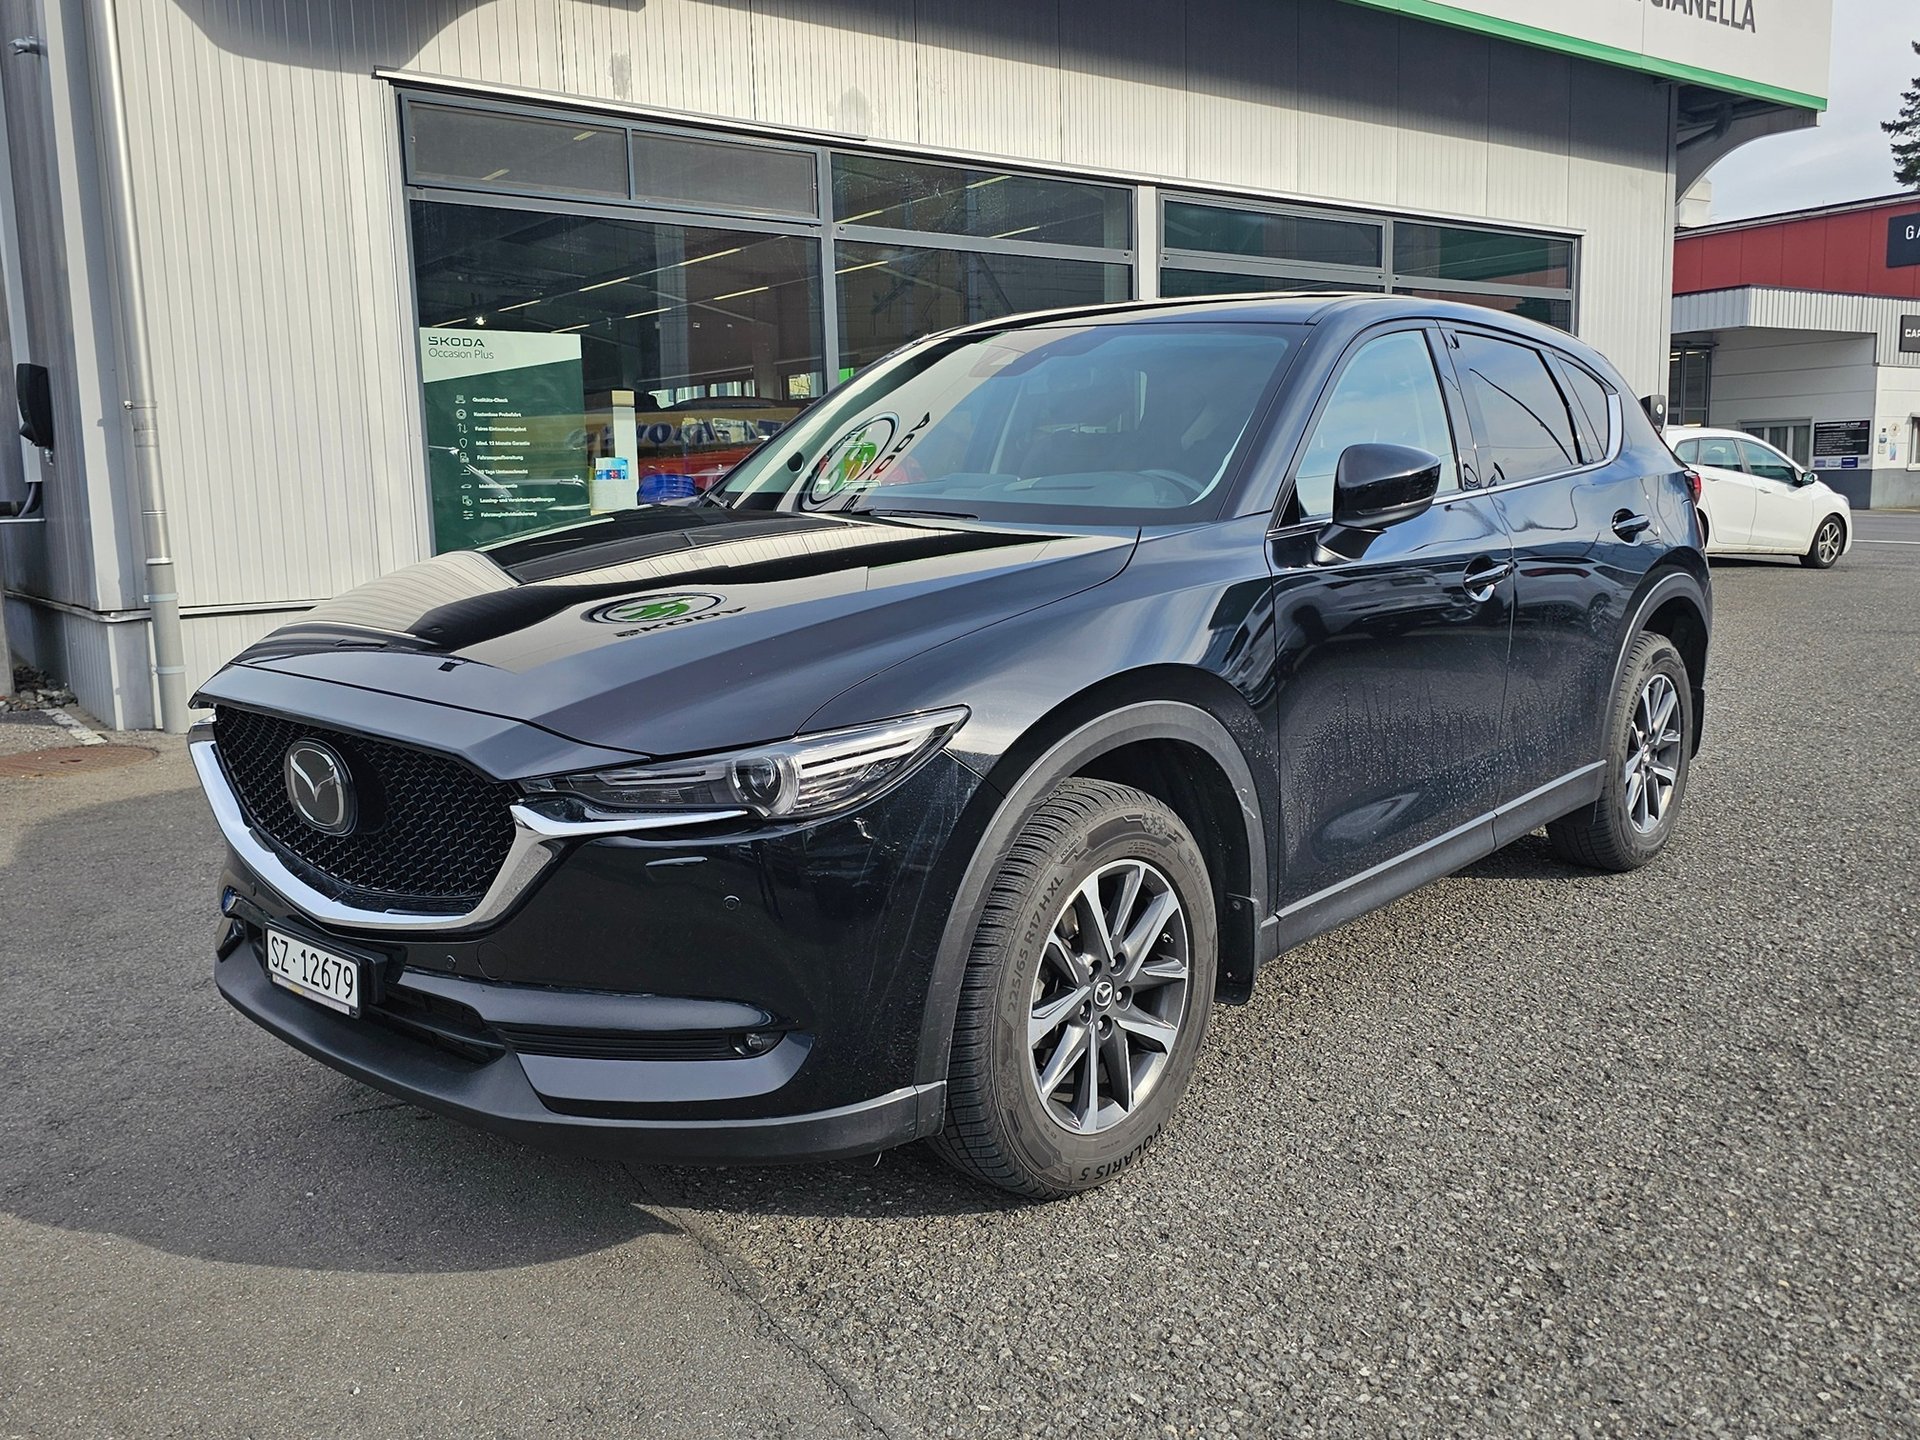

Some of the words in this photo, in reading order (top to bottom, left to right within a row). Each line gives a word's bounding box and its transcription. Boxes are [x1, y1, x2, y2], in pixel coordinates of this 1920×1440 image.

[428, 347, 472, 359] Occasion
[474, 349, 495, 360] Plus
[1007, 947, 1030, 1013] 225/65
[1023, 910, 1043, 945] R17
[1094, 1122, 1162, 1180] POLARIS
